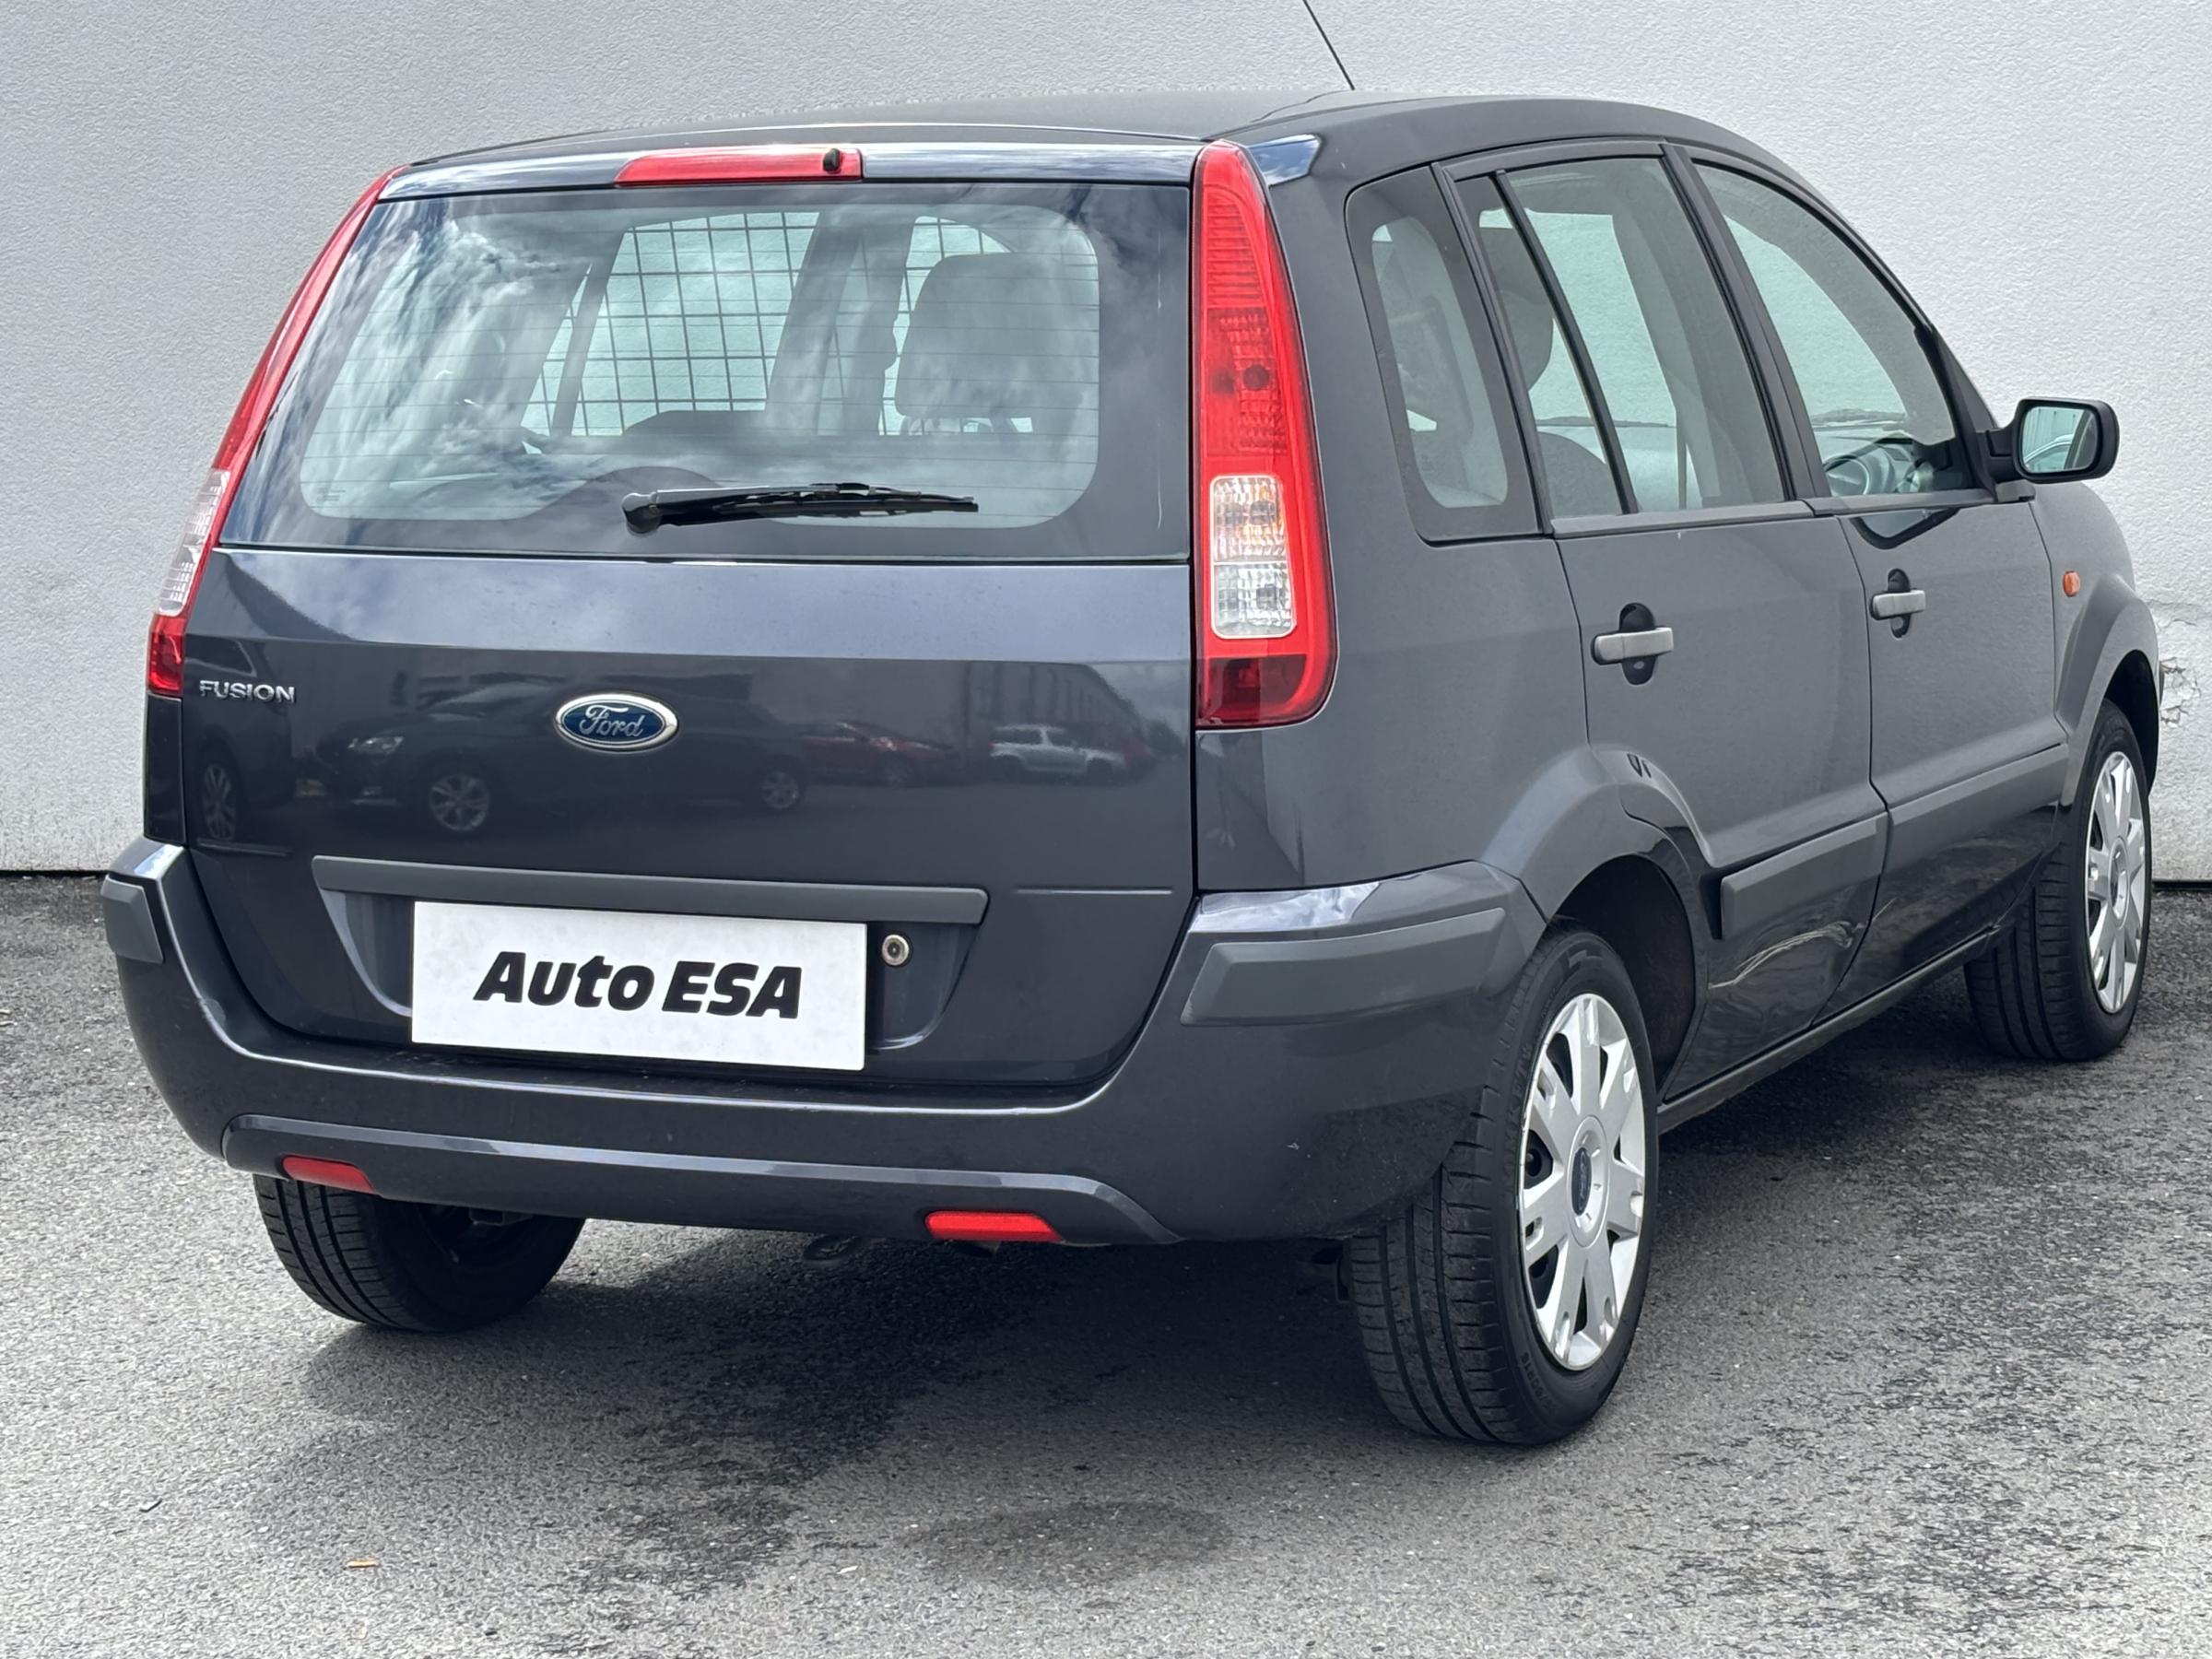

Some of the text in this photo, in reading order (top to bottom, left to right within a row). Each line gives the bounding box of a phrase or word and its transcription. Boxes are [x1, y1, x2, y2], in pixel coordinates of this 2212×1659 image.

[198, 679, 296, 703] FUSION
[578, 703, 646, 737] Ford
[473, 951, 802, 1019] Auto ESA
